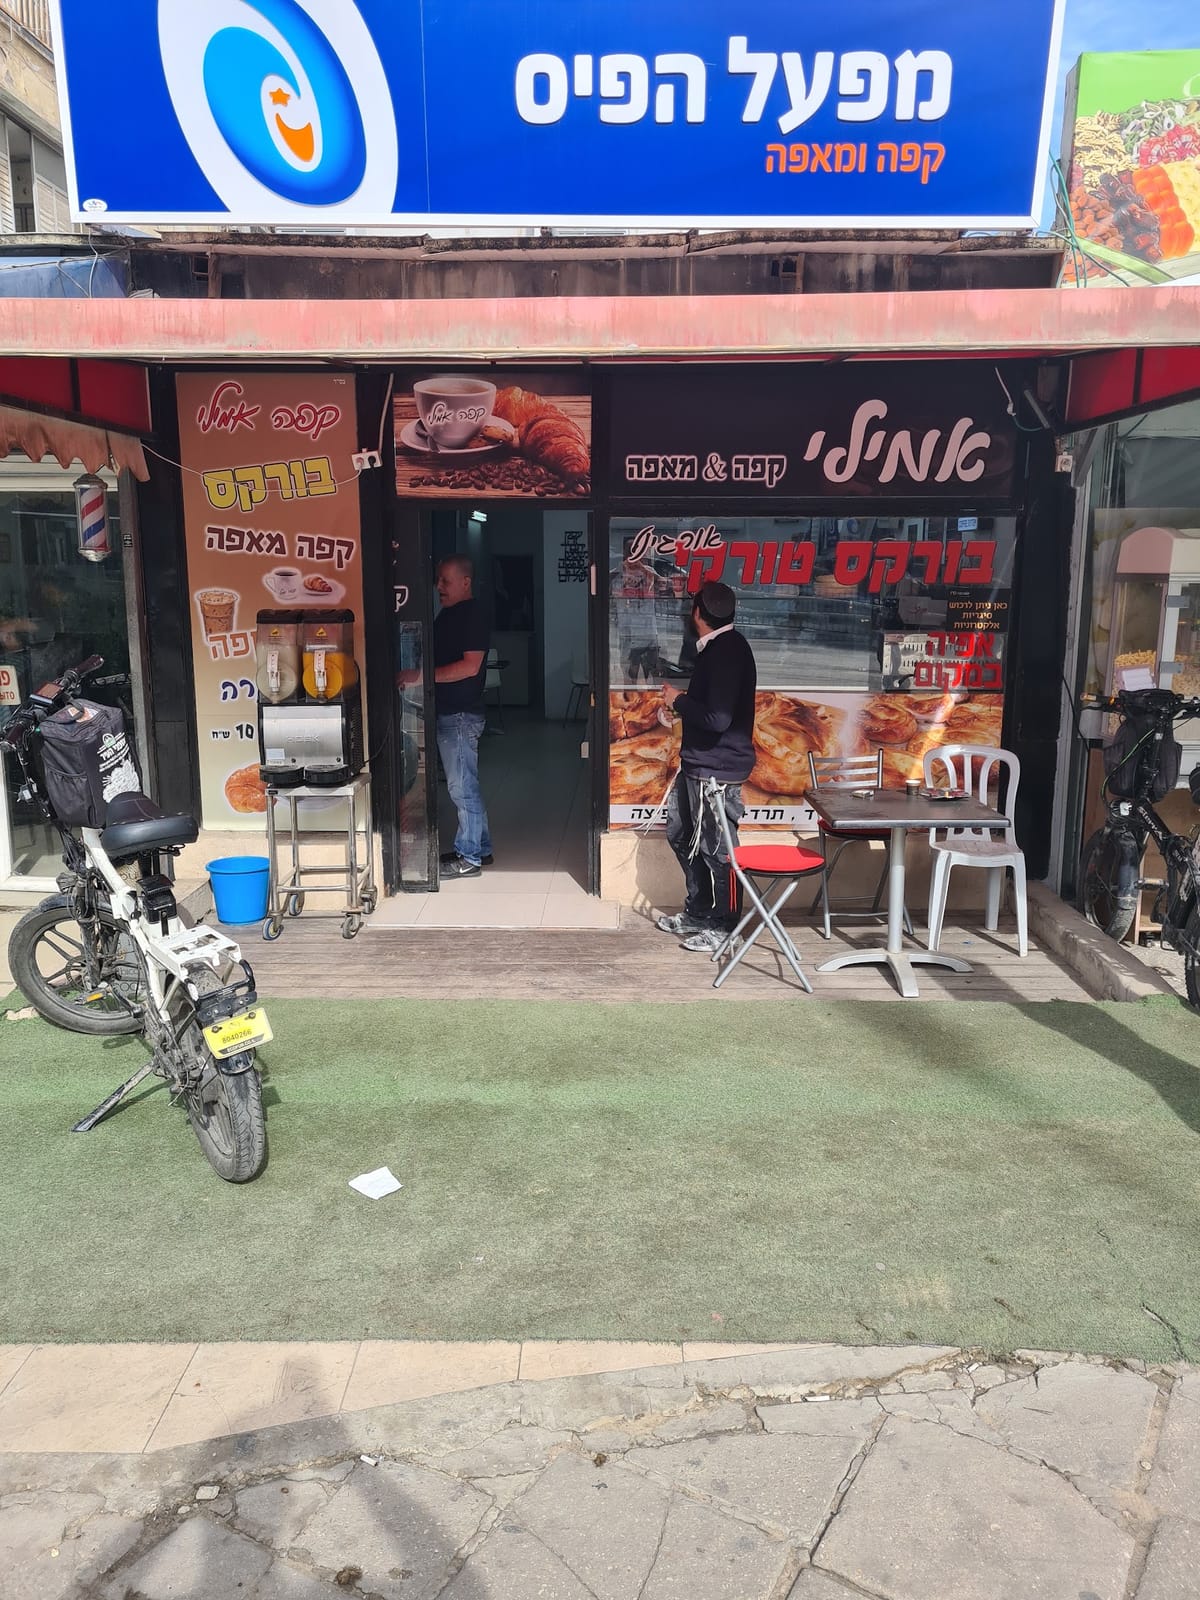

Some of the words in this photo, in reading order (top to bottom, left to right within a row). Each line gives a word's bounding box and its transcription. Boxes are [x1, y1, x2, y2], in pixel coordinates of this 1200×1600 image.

[515, 52, 706, 125] הפיס
[729, 36, 953, 134] מפעל
[766, 143, 866, 173] ומאפה
[877, 143, 946, 184] קפה
[271, 403, 341, 440] קפה
[803, 399, 991, 483] אמילי
[203, 456, 338, 512] בורקס
[626, 455, 697, 481] מאפה
[702, 452, 727, 481] &
[732, 454, 787, 488] קפה
[206, 526, 287, 556] מאפה
[296, 534, 355, 569] קפה
[674, 540, 816, 593] טורקי
[832, 540, 998, 594] בורקס
[926, 632, 995, 657] אפיה
[235, 723, 254, 740] 10
